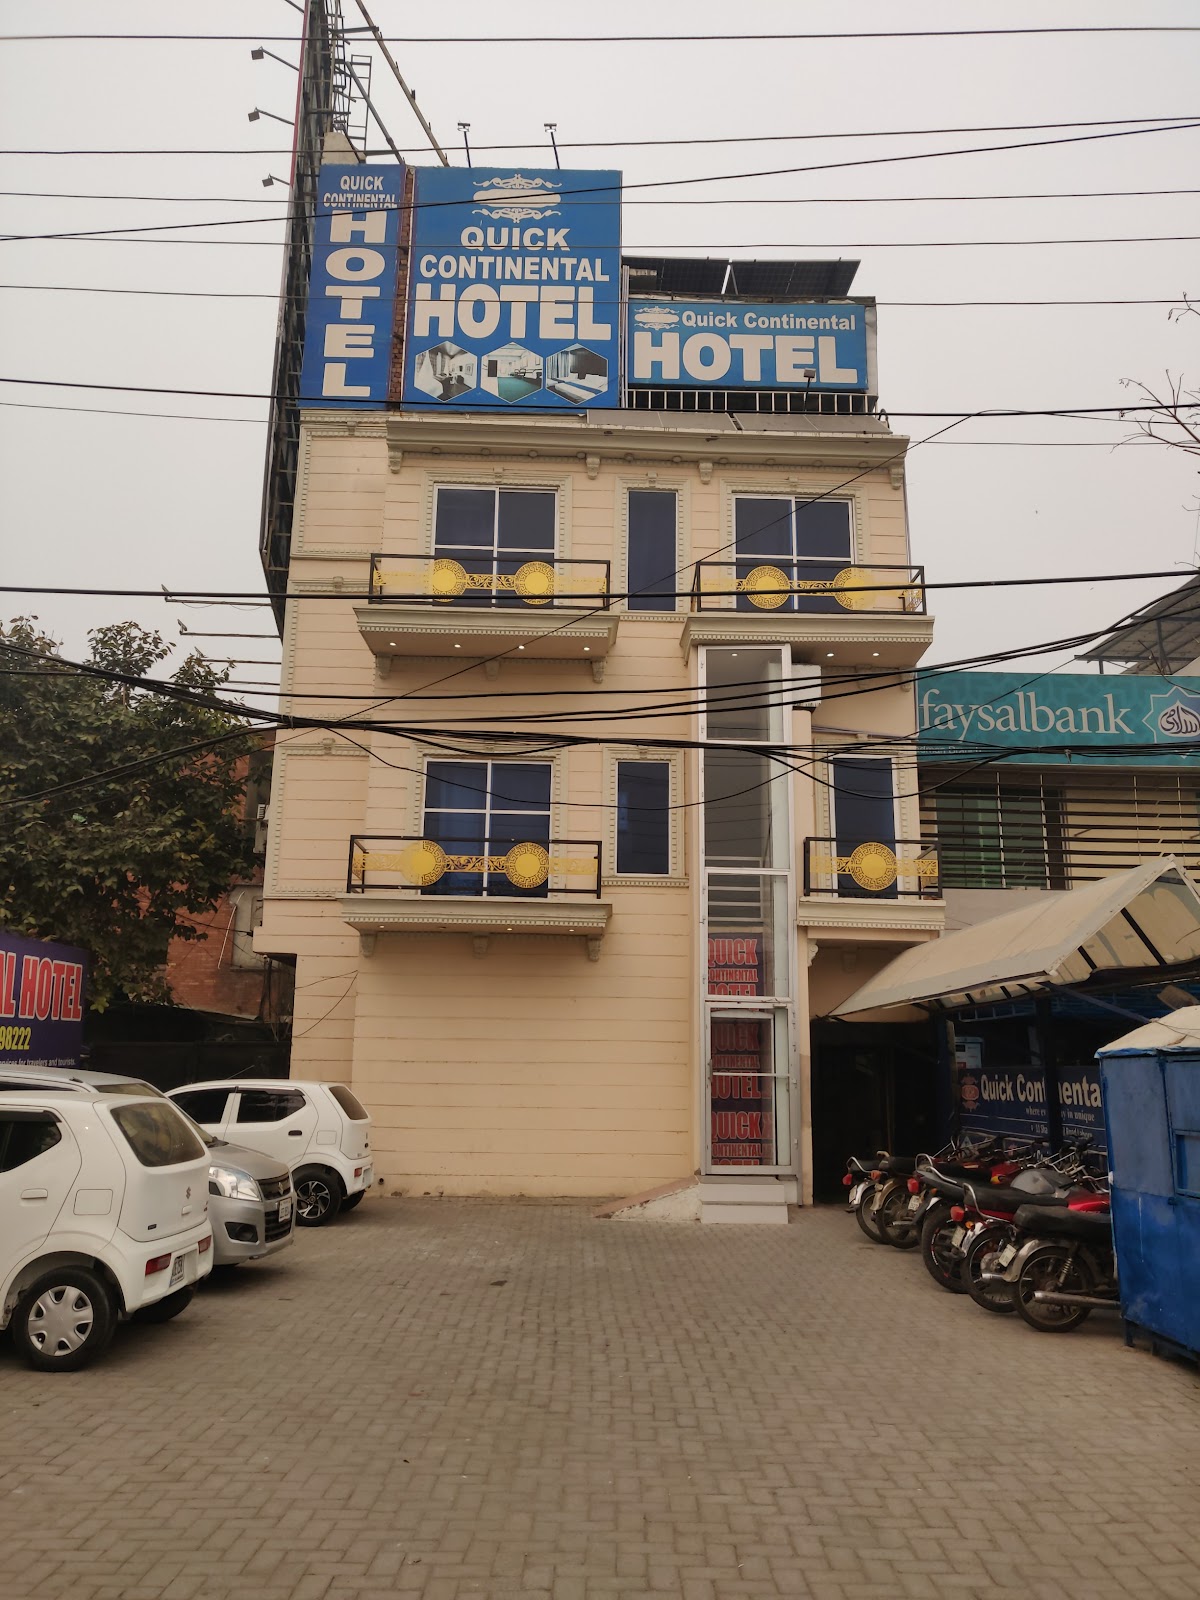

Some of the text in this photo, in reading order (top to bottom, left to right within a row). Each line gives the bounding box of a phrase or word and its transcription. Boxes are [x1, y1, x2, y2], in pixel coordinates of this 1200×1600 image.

[340, 175, 384, 191] QUICK
[323, 192, 398, 209] CONTINENTAL
[460, 226, 571, 252] QUICK
[420, 254, 610, 282] CONTINENTAL
[322, 209, 387, 397] HOTEL
[413, 282, 612, 340] HOTEL
[681, 310, 856, 331] Quick Continental
[633, 331, 858, 384] HOTEL
[919, 688, 1136, 743] faysalbank
[18, 954, 83, 1021] HOTEL
[708, 968, 758, 983] ONTINENTAL
[712, 1054, 761, 1069] ONTINENTAL
[980, 1074, 1102, 1108] Quick Conenta
[711, 1143, 762, 1158] ONTINENTAL
